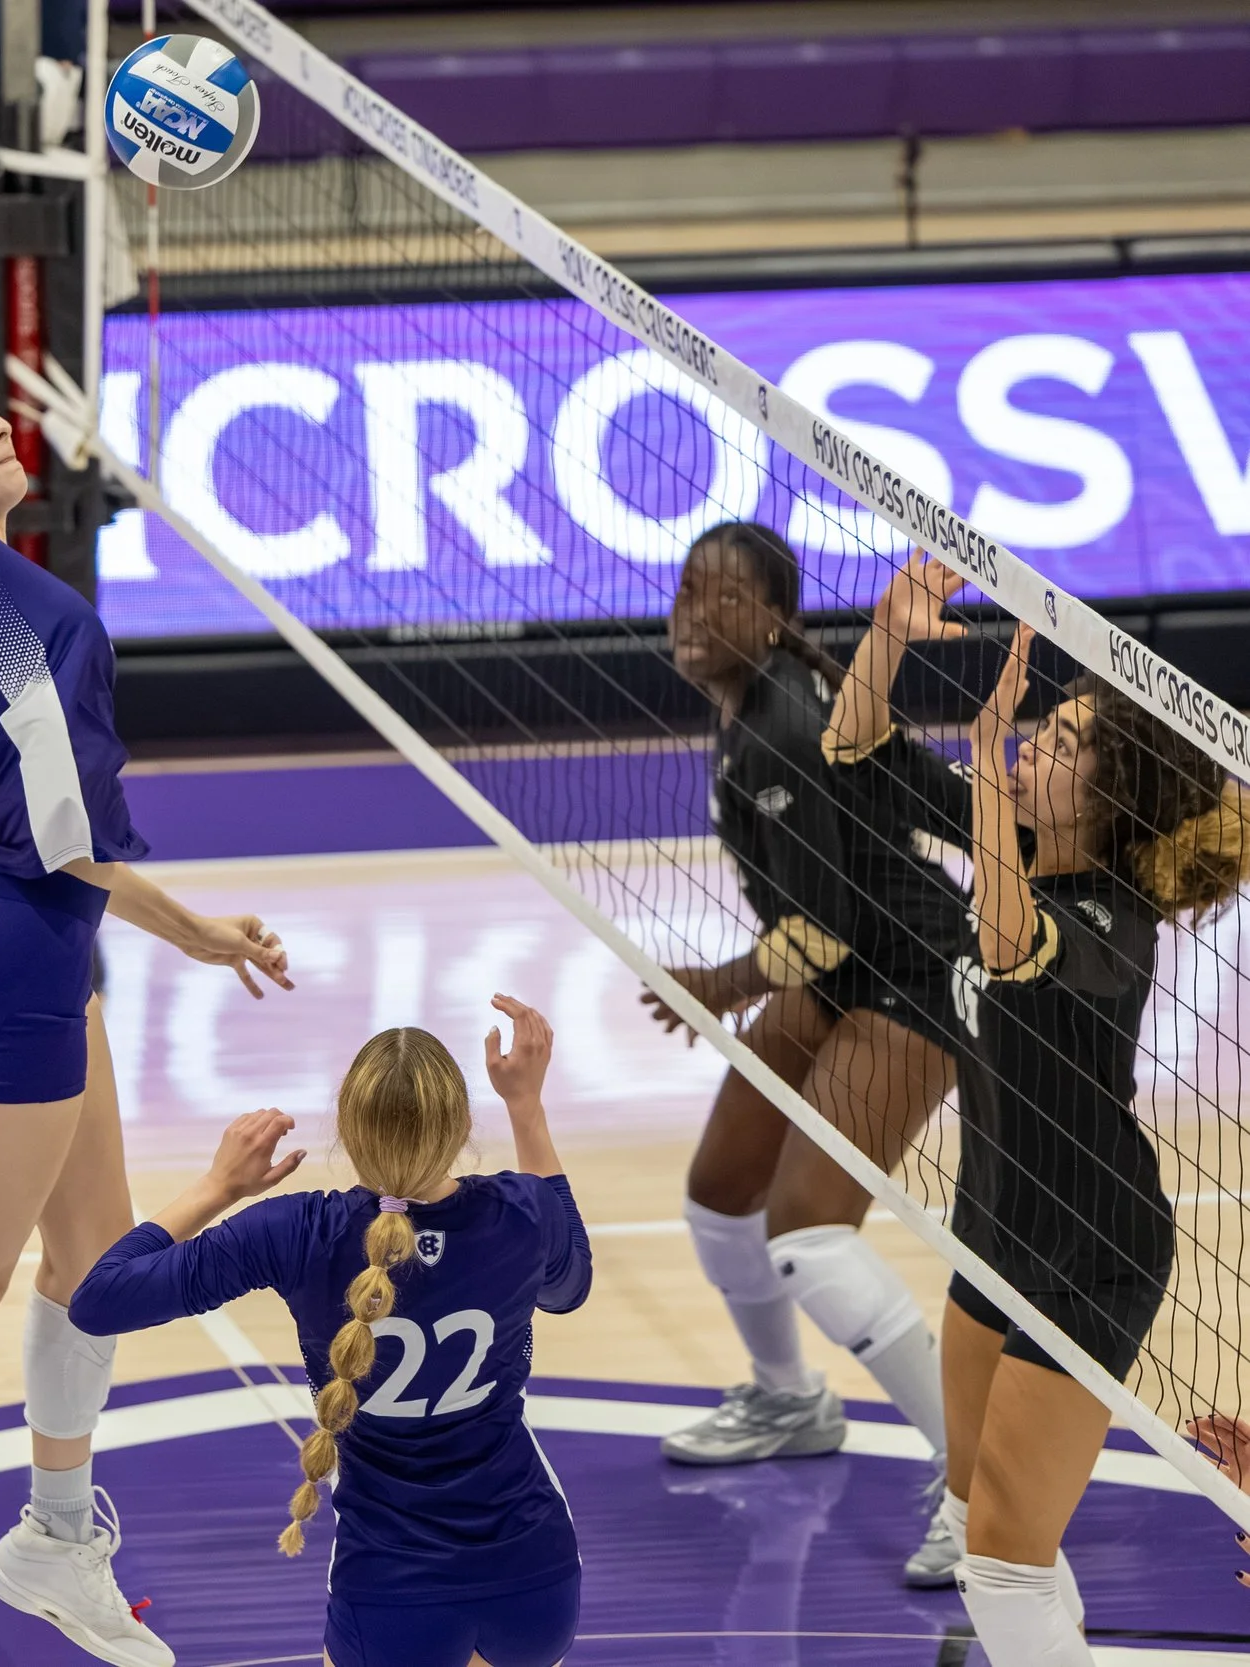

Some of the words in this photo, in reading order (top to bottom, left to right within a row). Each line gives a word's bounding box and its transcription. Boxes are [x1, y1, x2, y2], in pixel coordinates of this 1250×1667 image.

[140, 87, 209, 140] NCAA
[153, 62, 191, 86] Touch
[193, 83, 225, 112] Super
[124, 112, 202, 164] molten
[593, 266, 636, 326] CROSS
[637, 298, 718, 386] CRUSADERS
[813, 420, 850, 481] HOLY
[852, 451, 904, 519] CROSS
[906, 488, 998, 587] CRUSADERS
[1109, 630, 1153, 698] HOLY
[1156, 666, 1218, 744] CROSS
[358, 1309, 498, 1418] 22
